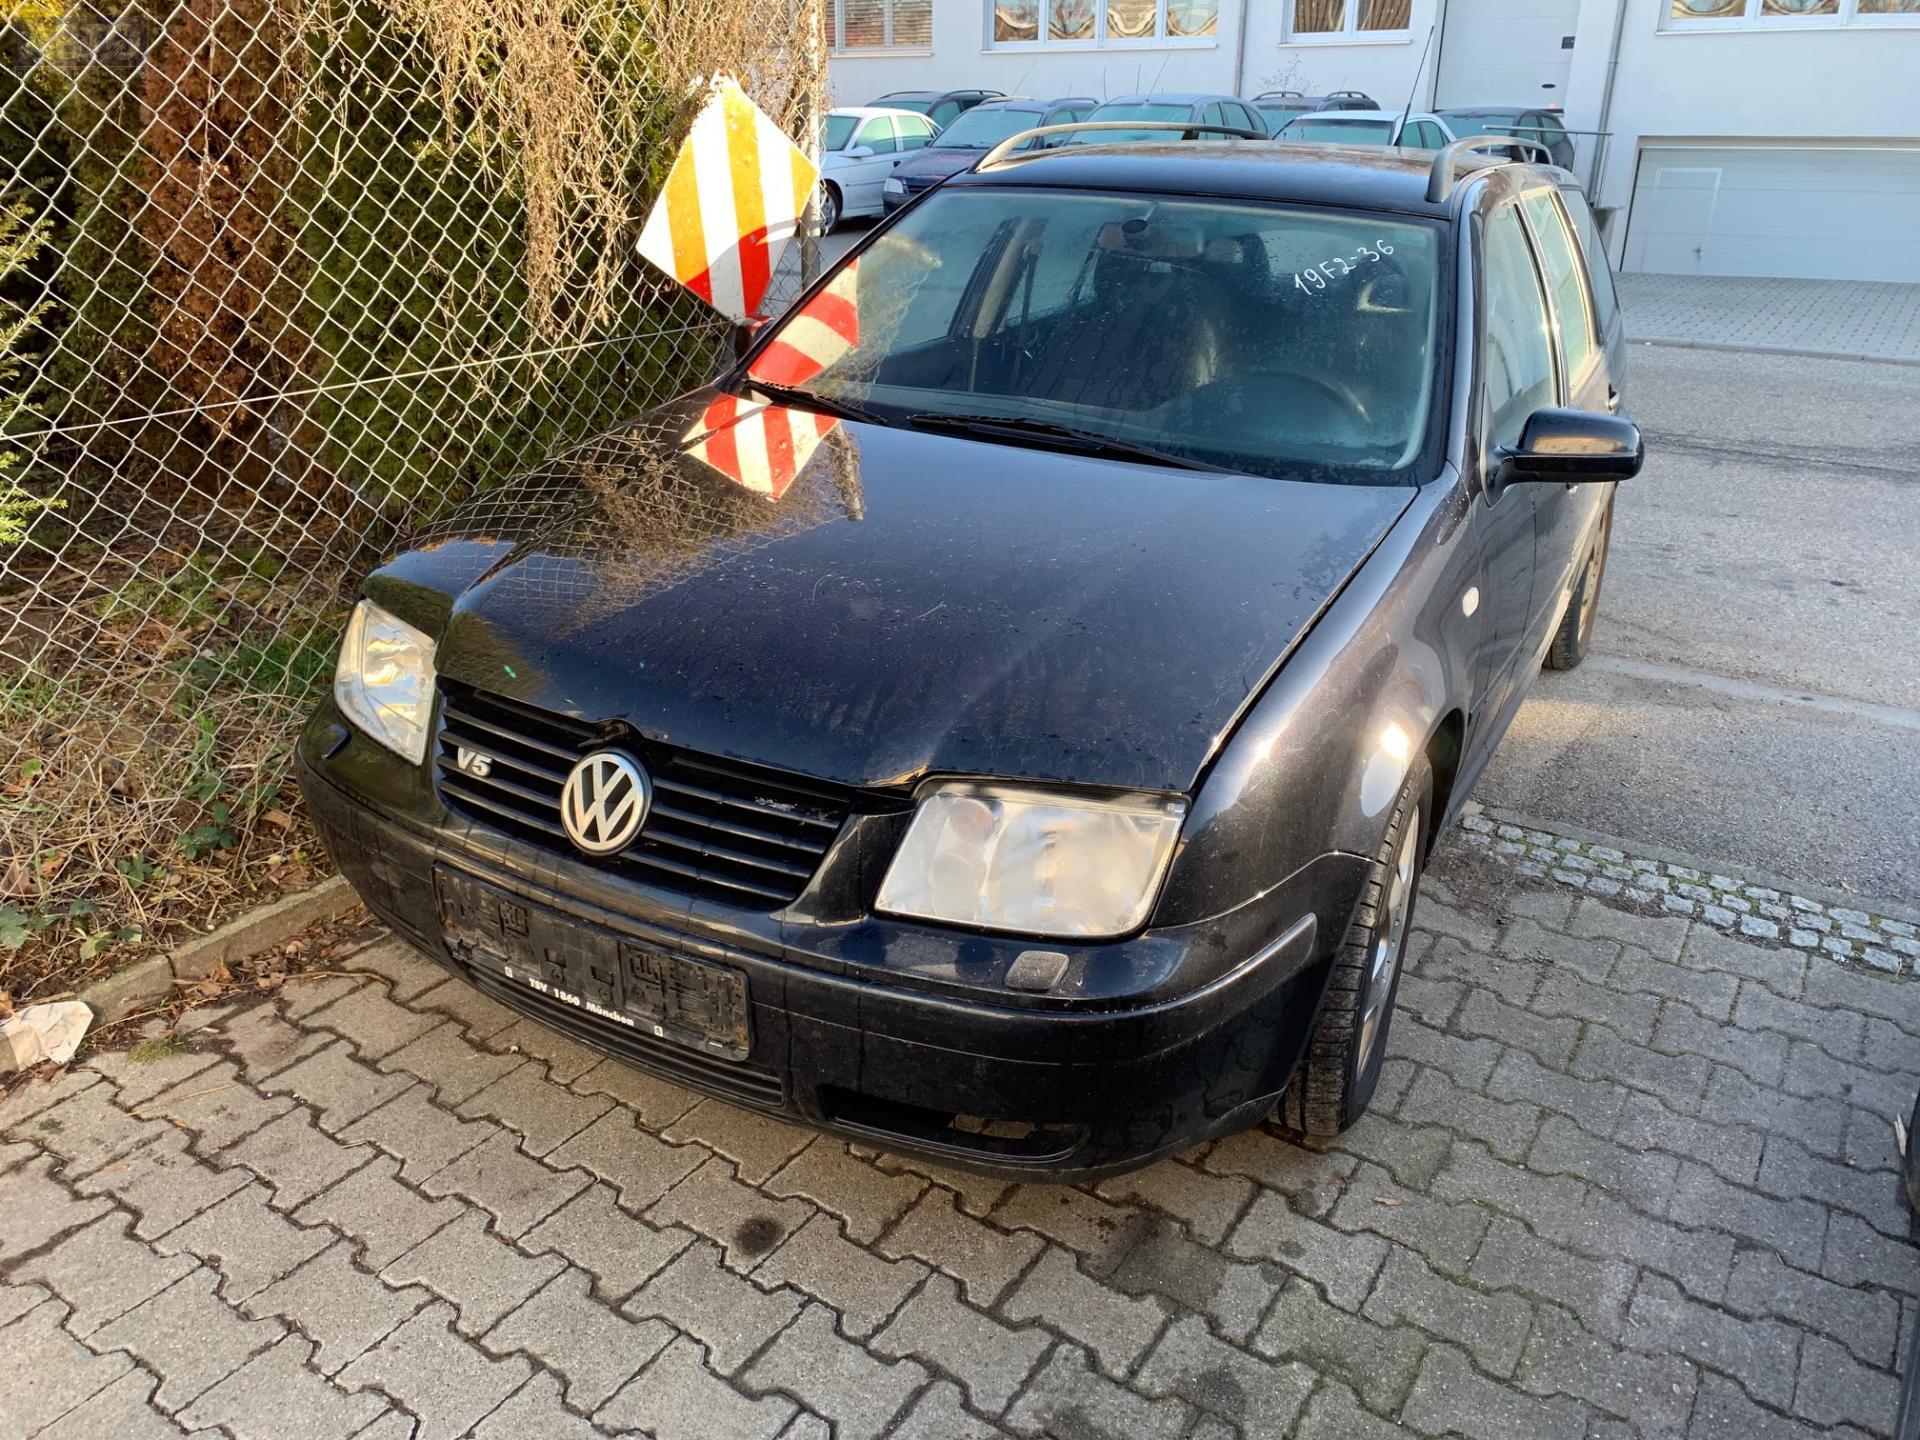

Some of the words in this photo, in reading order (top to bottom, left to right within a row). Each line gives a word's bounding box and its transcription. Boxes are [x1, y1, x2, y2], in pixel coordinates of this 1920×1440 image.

[1295, 239, 1394, 296] 19F2-36
[457, 747, 492, 777] V5
[565, 755, 645, 849] VW
[528, 977, 548, 993] TSV
[553, 988, 581, 1007] 1860
